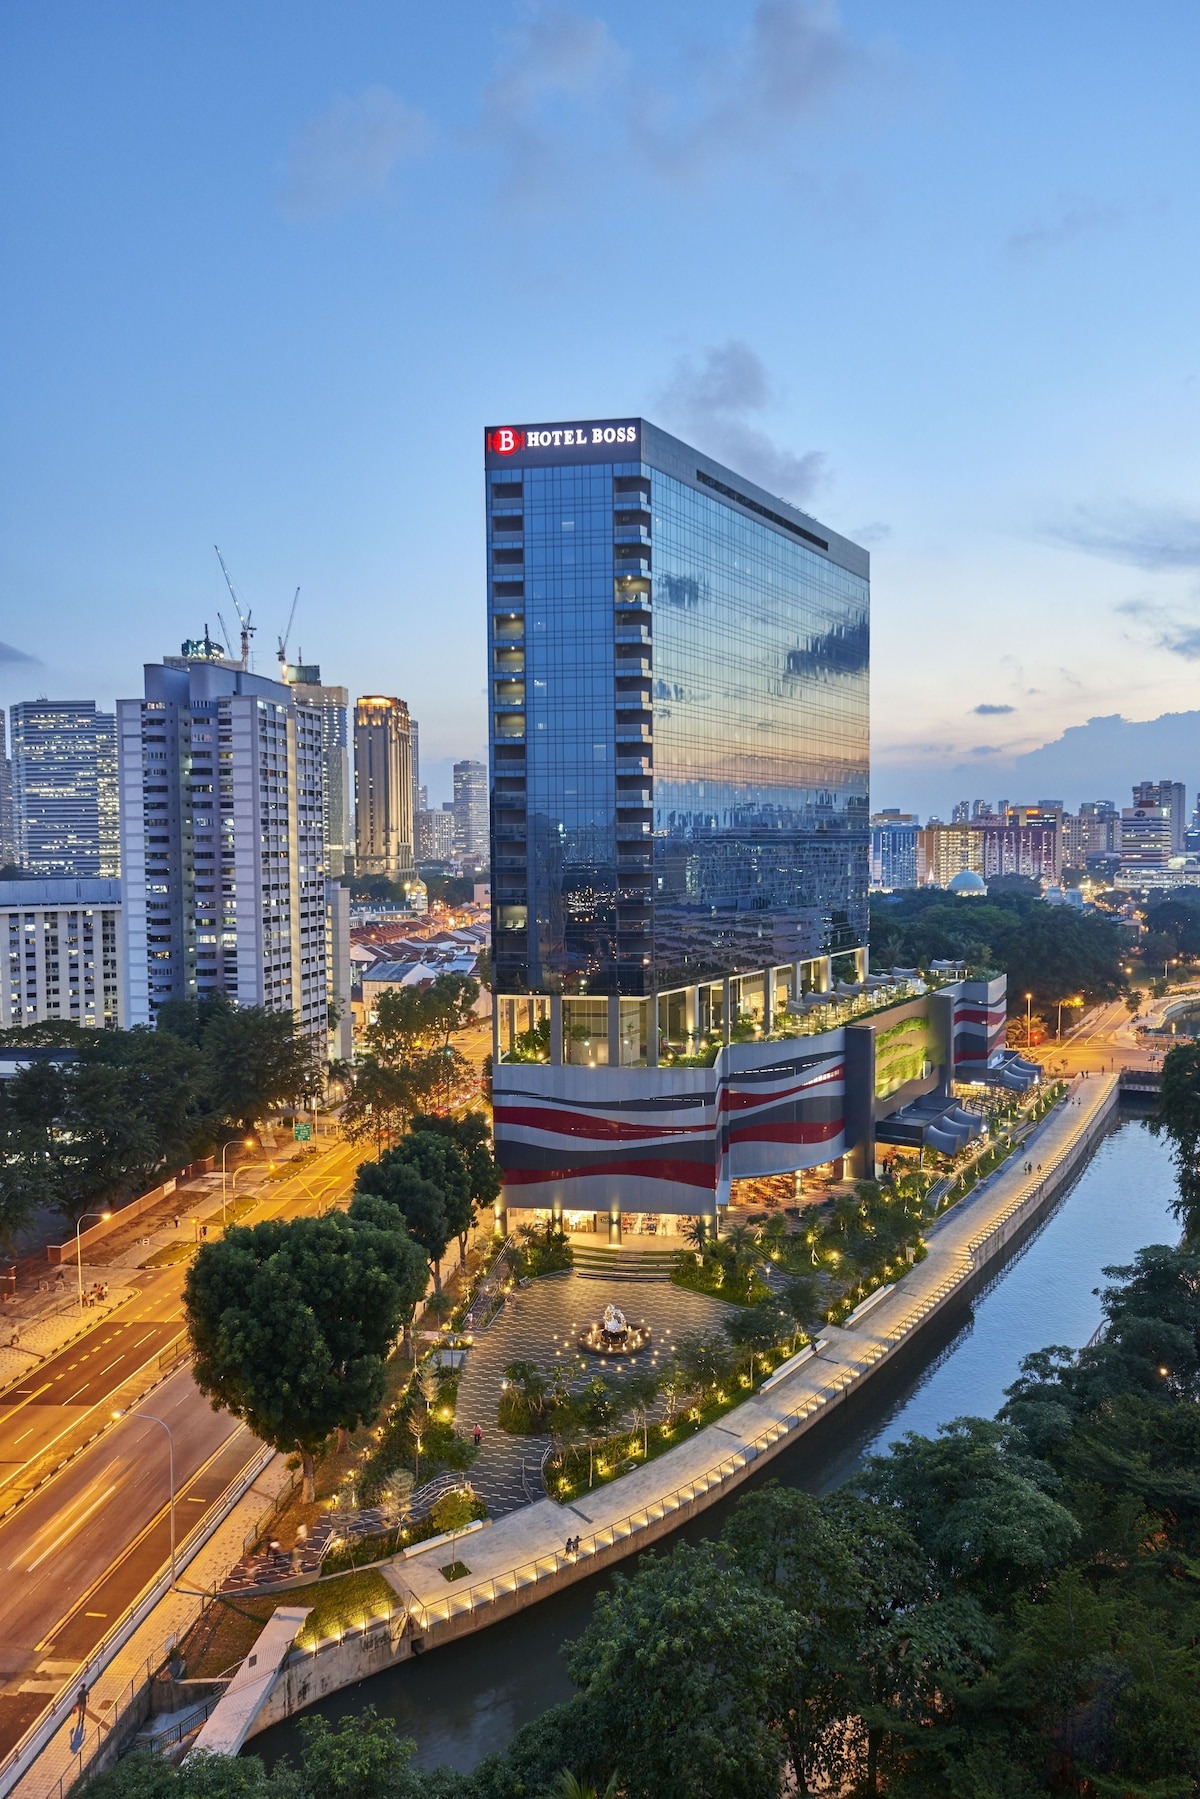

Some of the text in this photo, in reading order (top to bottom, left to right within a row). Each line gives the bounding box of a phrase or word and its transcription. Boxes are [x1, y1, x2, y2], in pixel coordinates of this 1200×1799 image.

[499, 427, 637, 452] B HOTEL BOSS
